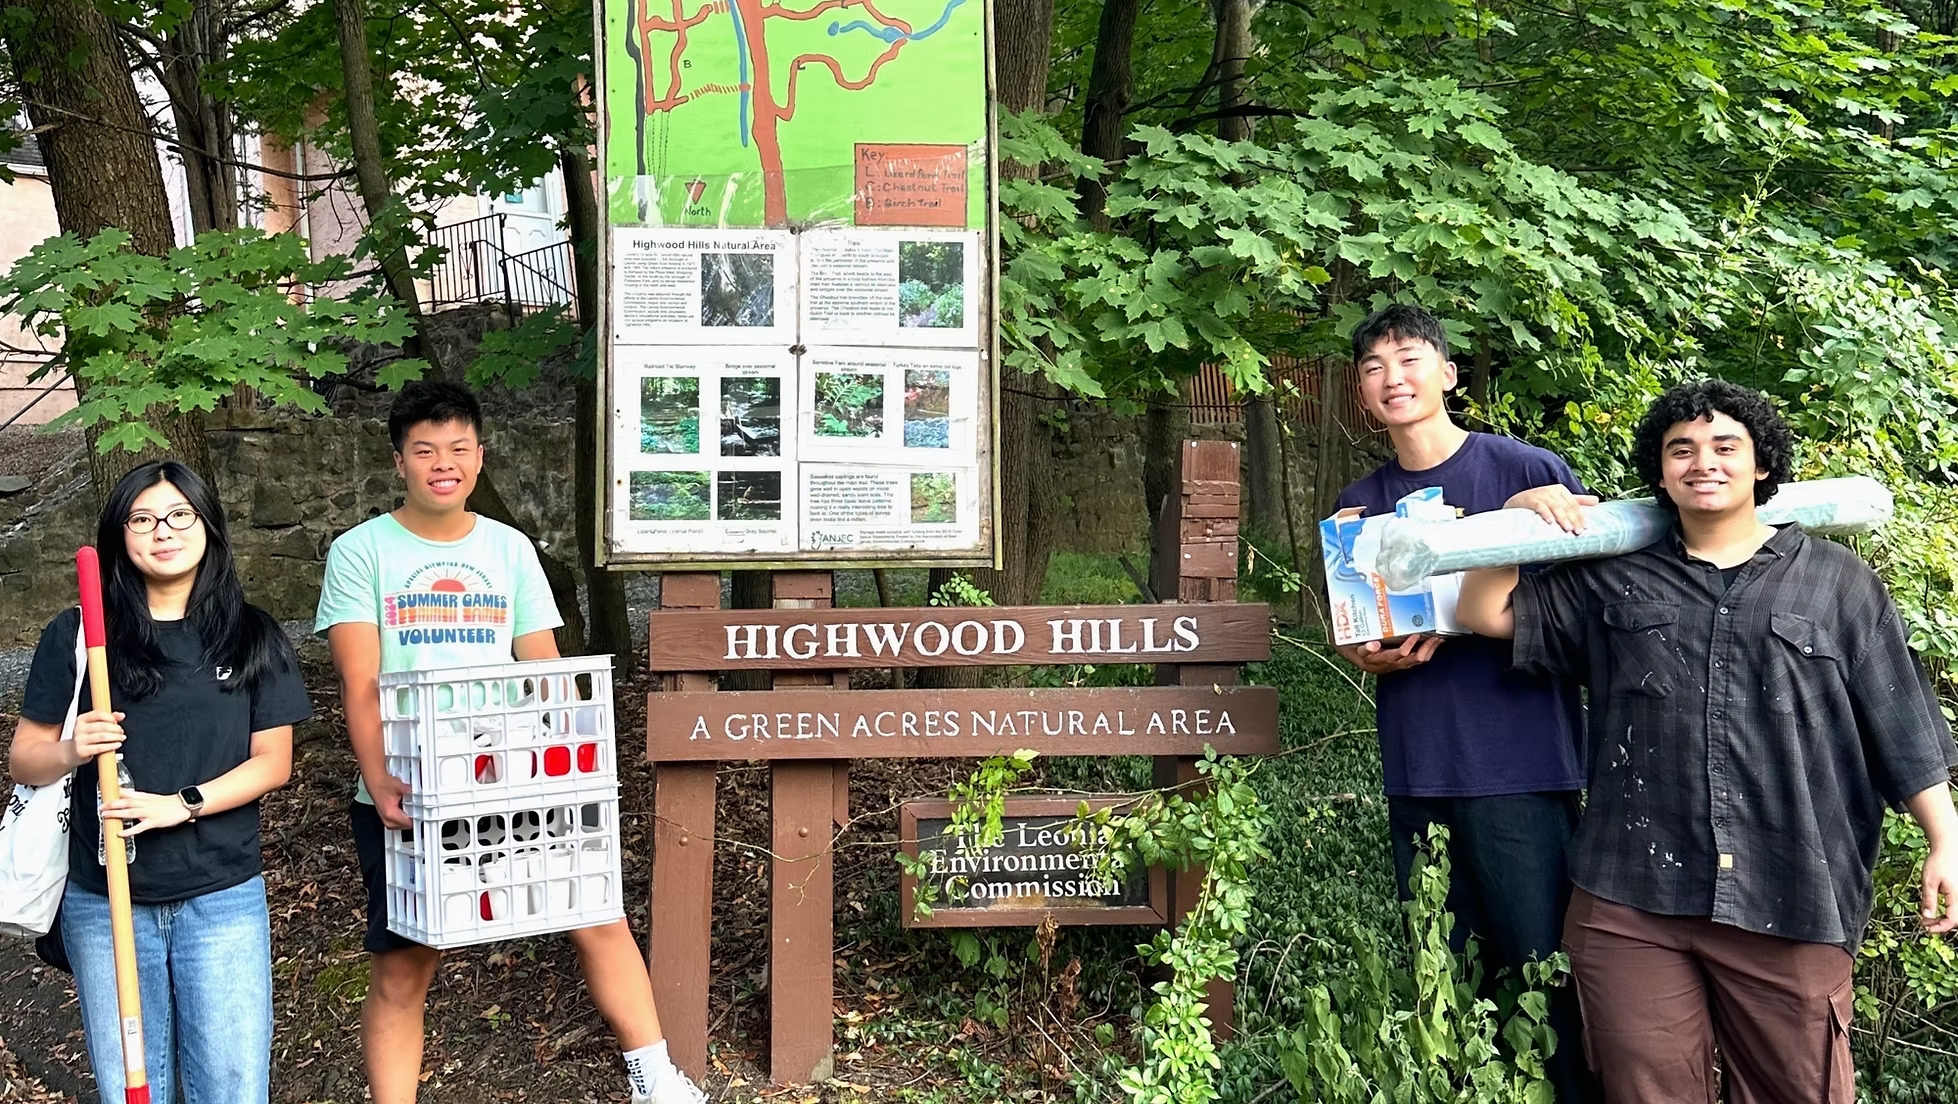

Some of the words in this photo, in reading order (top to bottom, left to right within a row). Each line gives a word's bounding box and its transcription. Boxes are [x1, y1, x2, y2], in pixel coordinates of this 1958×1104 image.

[683, 60, 691, 68] B
[862, 148, 888, 163] Key:
[883, 183, 936, 192] Chestnut
[942, 183, 964, 193] Trail
[685, 206, 711, 216] North
[884, 199, 915, 207] Birch
[918, 198, 941, 207] Trail
[633, 240, 684, 250] Highwood
[688, 240, 710, 249] Hills
[714, 241, 750, 250] Natural
[752, 241, 776, 250] Area
[398, 593, 458, 608] SUMMER
[463, 593, 507, 608] GAMES
[1374, 577, 1383, 607] FORCE
[385, 596, 397, 626] 2024
[1335, 600, 1351, 640] HDX
[1350, 594, 1358, 623] Kitchen
[1379, 606, 1388, 632] DURA
[399, 628, 495, 646] VOLUNTEER
[723, 619, 1025, 660] HIGHWOOD
[1048, 615, 1200, 655] HILLS
[690, 716, 711, 740] A
[724, 712, 841, 742] GREEN
[851, 710, 960, 738] ACRES
[971, 710, 1136, 738] NATURAL
[1146, 709, 1236, 738] AREA
[930, 842, 1133, 874] Environmena
[945, 873, 1121, 899] Commission
